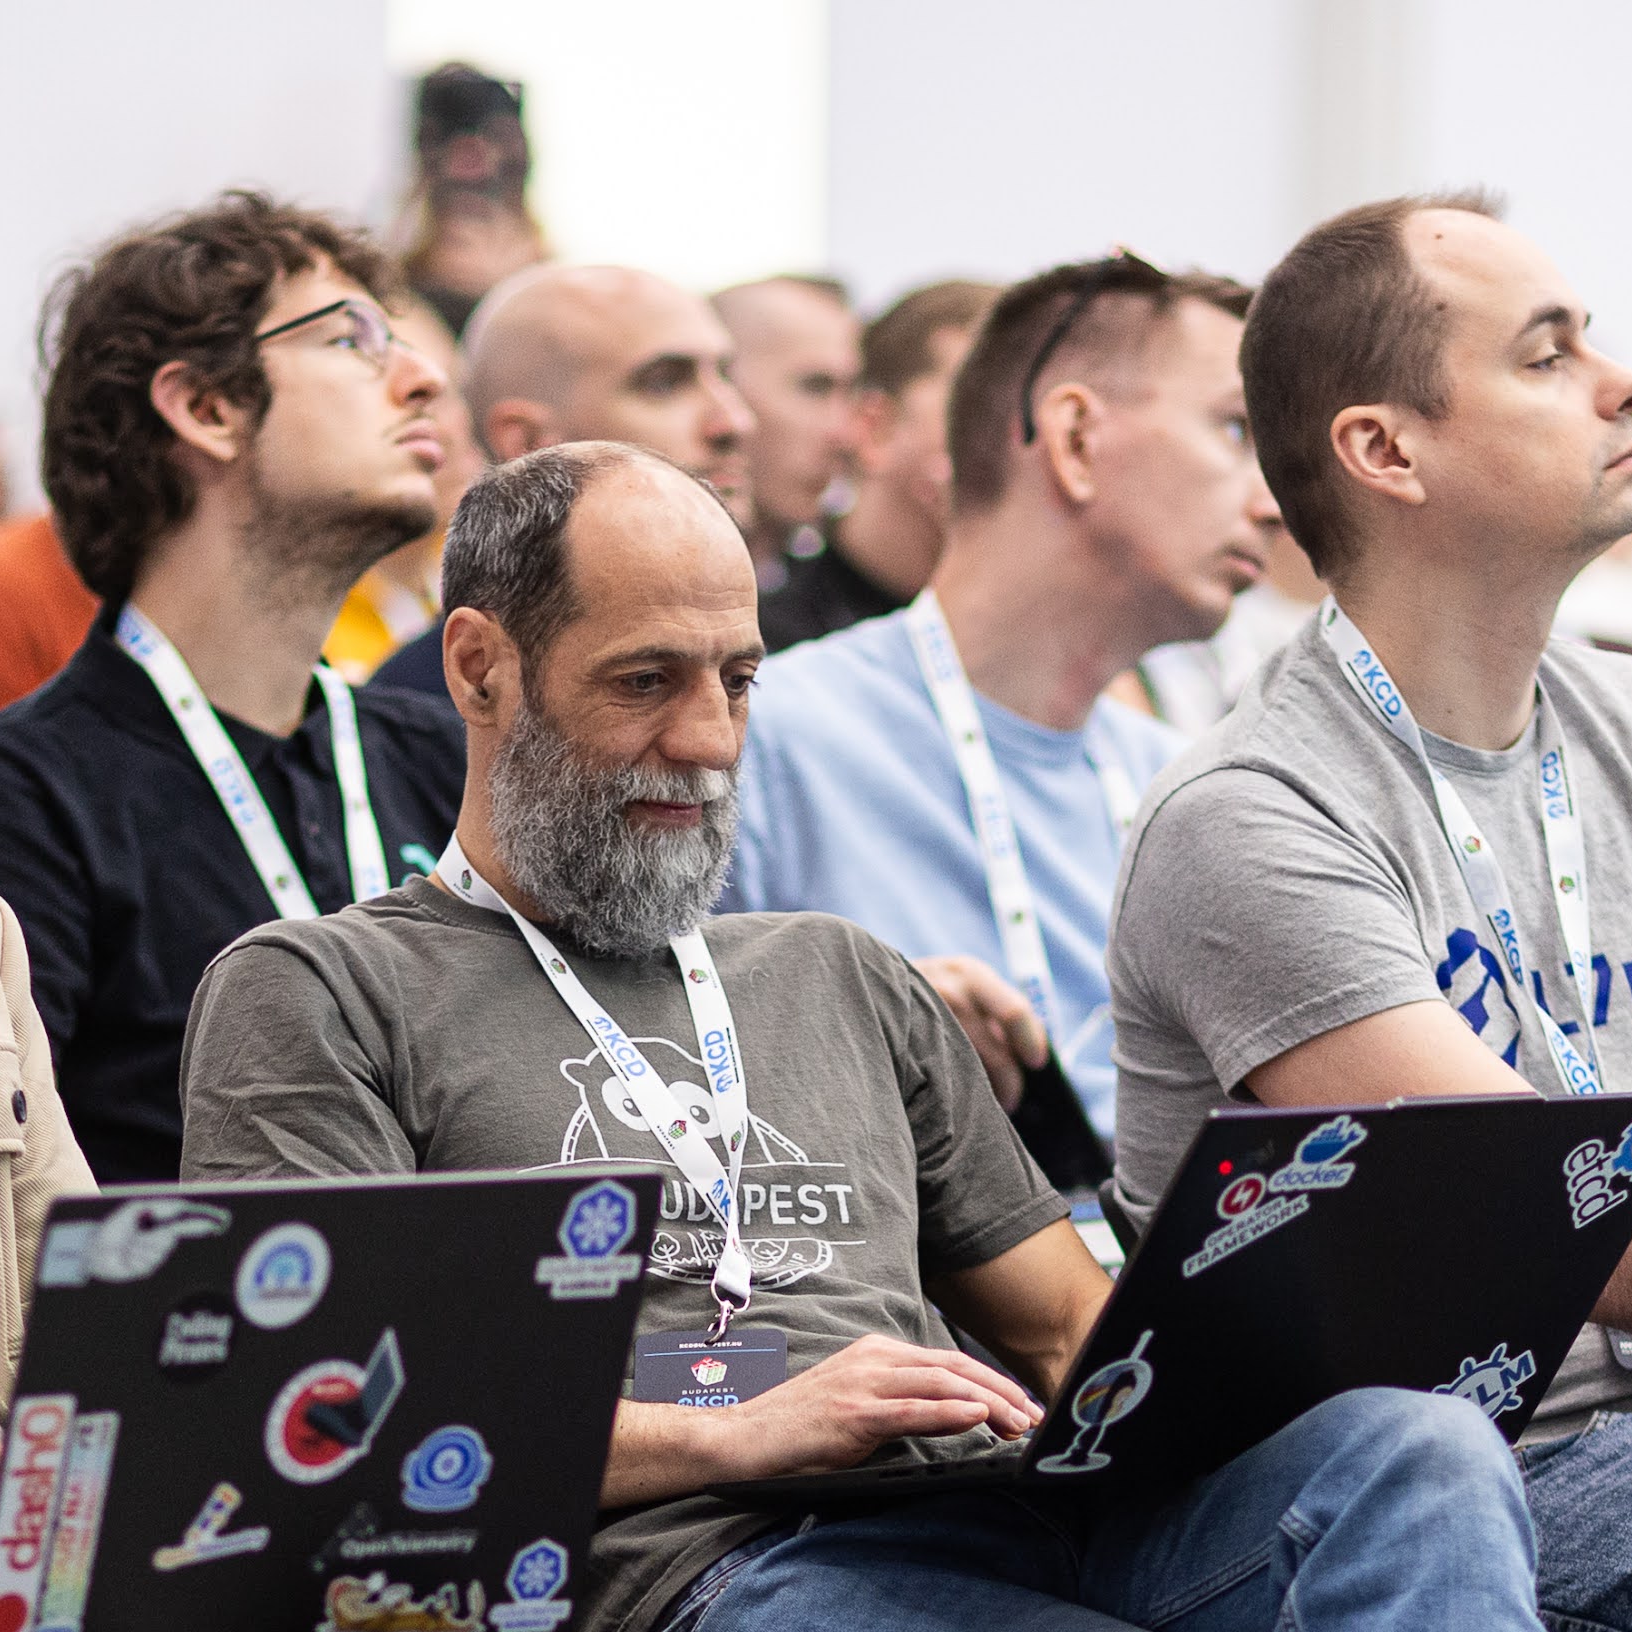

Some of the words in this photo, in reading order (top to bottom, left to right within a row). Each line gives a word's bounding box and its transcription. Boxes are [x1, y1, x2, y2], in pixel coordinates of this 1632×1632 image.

[1363, 664, 1402, 717] KCD
[605, 1032, 647, 1077] KCD
[703, 1030, 731, 1078] KCD
[1274, 1165, 1349, 1187] docker
[1567, 1142, 1624, 1226] etcd
[661, 1180, 854, 1226] UDPEST
[1186, 1199, 1306, 1274] FRAMEWORK
